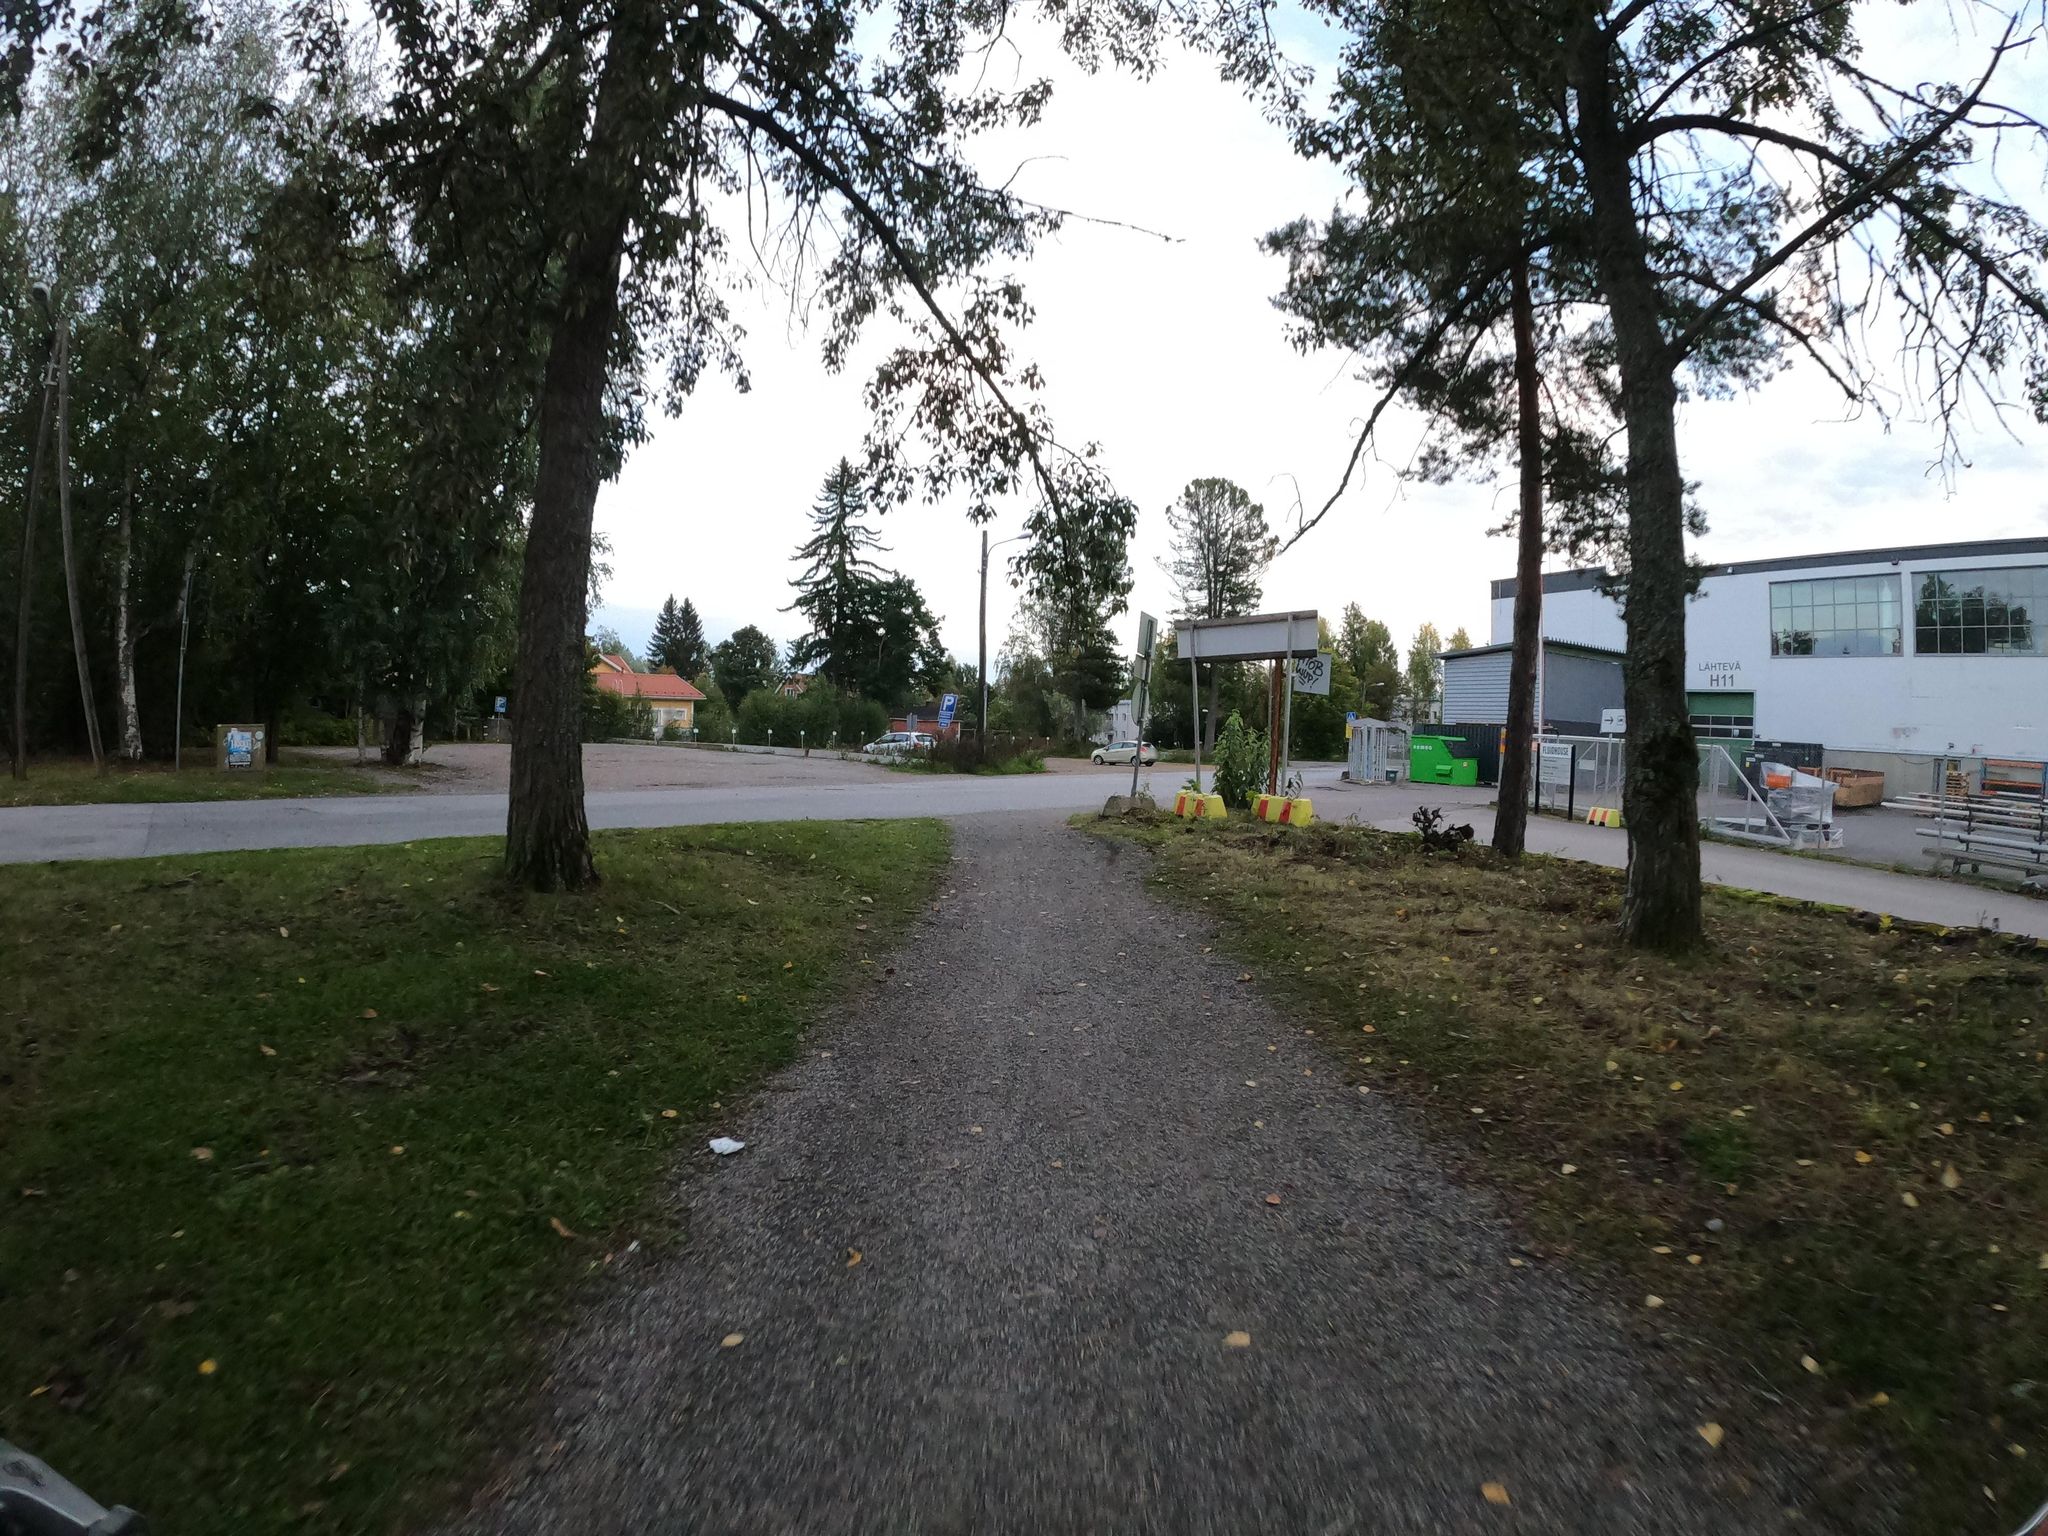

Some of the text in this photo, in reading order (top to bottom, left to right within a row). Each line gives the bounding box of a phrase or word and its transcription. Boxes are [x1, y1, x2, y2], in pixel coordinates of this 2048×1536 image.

[1698, 661, 1741, 671] LÄHTEVÄ
[1710, 674, 1734, 687] H11
[943, 696, 954, 710] P
